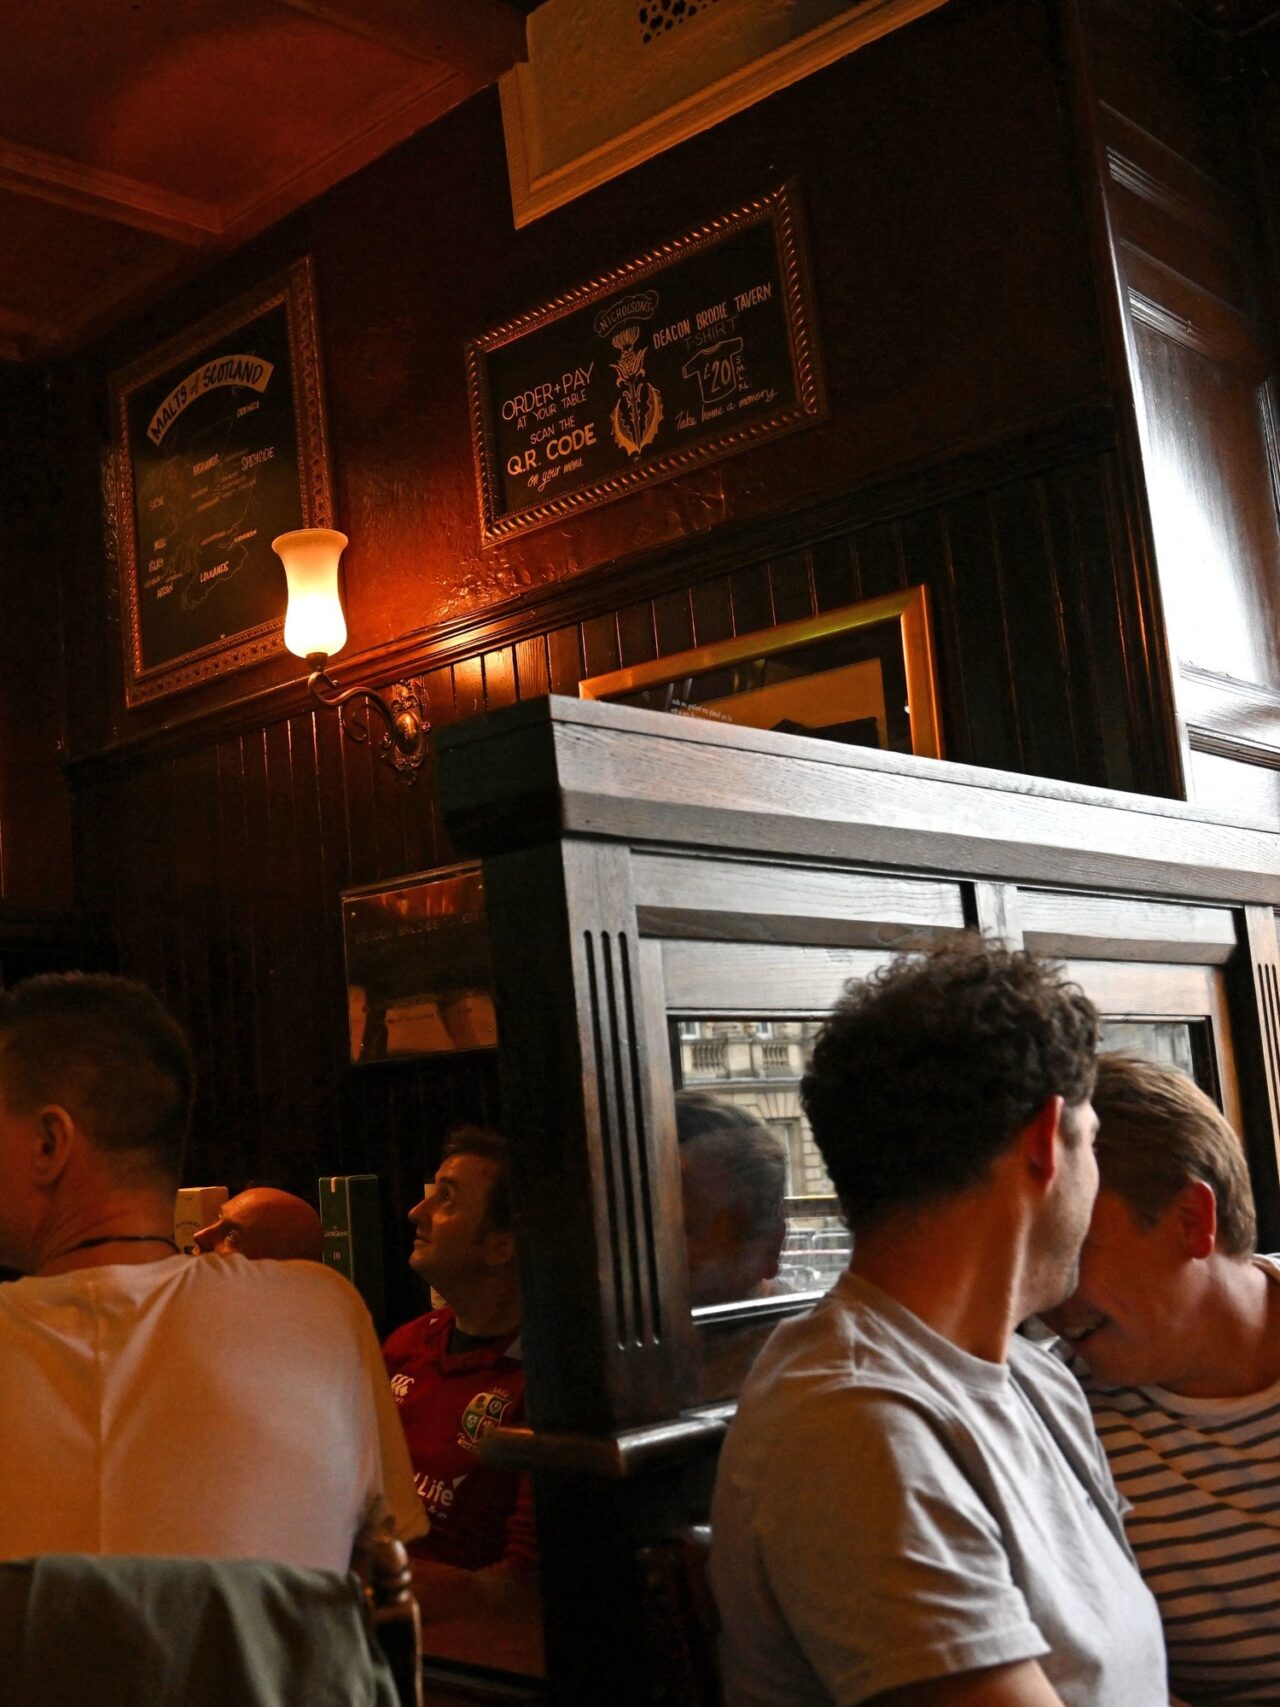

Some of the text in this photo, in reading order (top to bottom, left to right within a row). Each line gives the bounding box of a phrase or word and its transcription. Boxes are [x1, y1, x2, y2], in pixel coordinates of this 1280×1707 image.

[652, 282, 772, 350] DEACON BRODIE TAVERN
[151, 384, 187, 440] MALTS
[203, 359, 264, 388] SCOTLAND
[517, 388, 587, 431] AT YOUR TABLE
[530, 415, 576, 445] SCAN THE
[546, 422, 597, 460] CODE
[537, 465, 561, 492] your
[416, 1475, 455, 1507] Life
